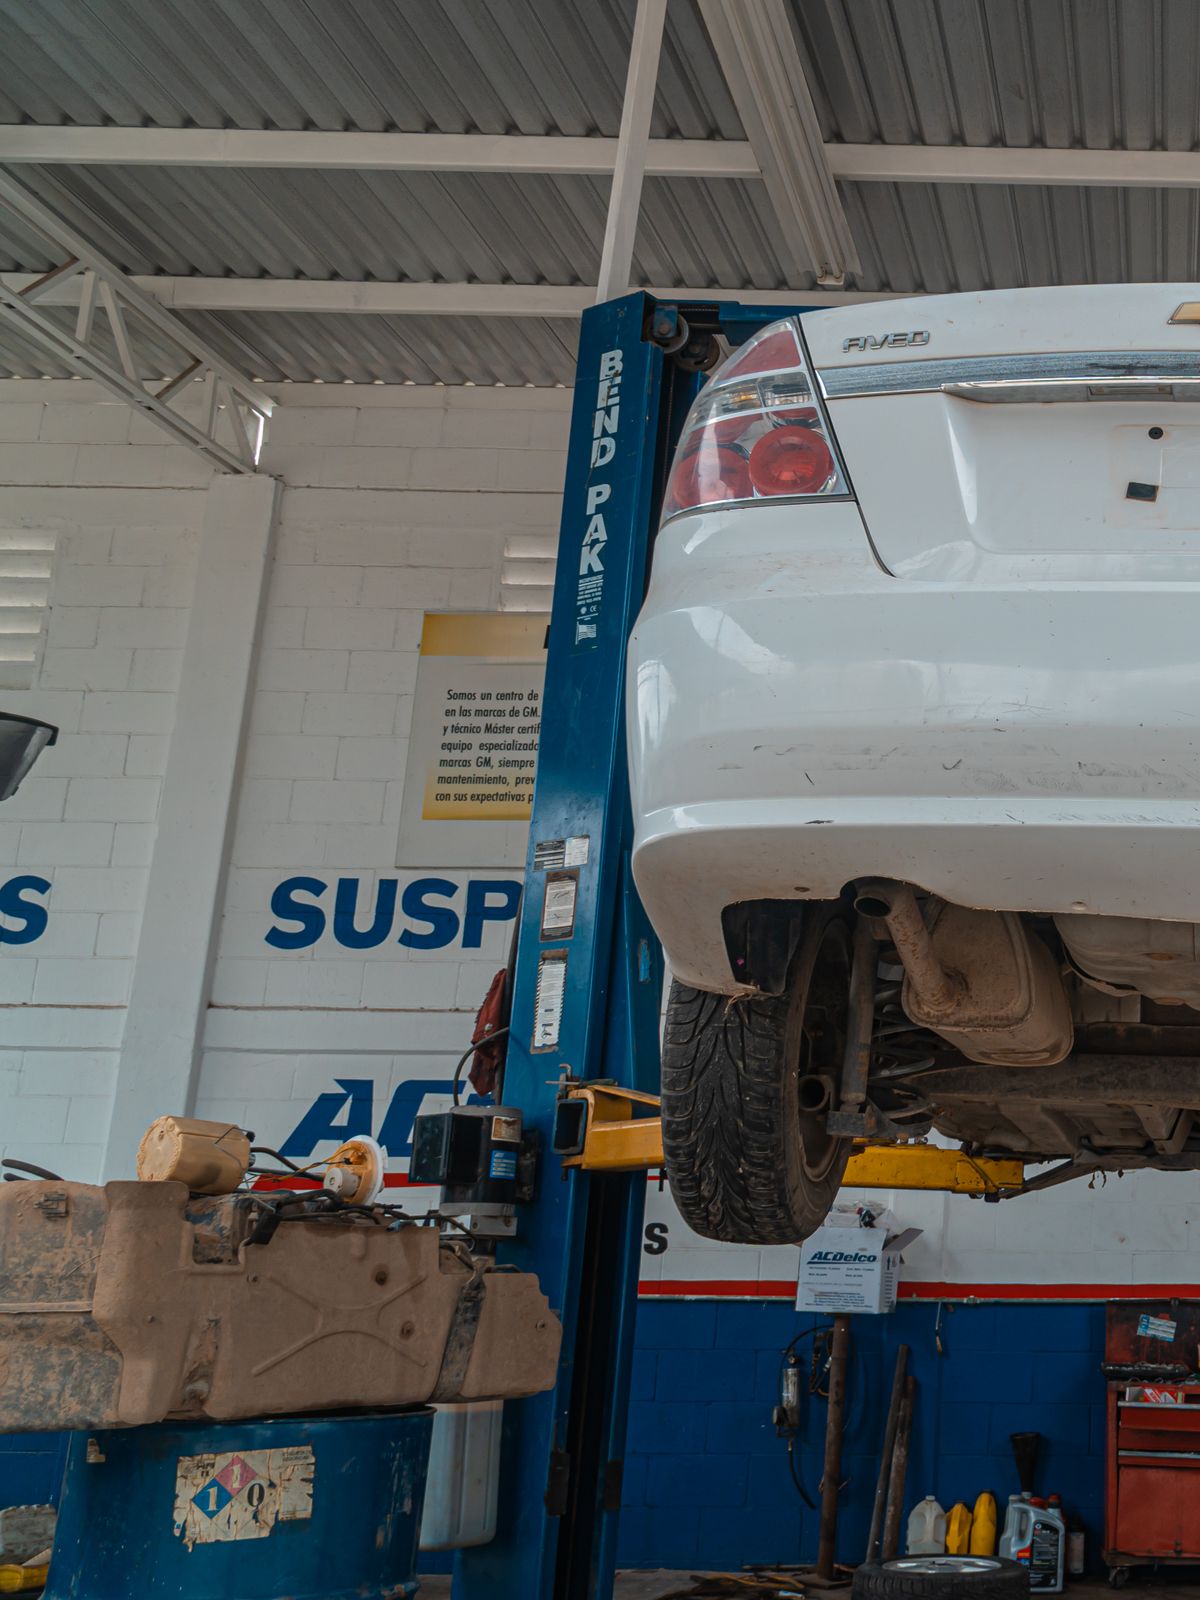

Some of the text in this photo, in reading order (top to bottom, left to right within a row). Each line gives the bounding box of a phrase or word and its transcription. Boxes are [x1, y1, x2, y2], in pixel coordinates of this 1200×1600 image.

[842, 330, 930, 353] AVEO
[590, 349, 624, 469] BEND
[579, 483, 612, 576] PAK
[447, 689, 539, 701] Somos un centro de
[445, 708, 456, 717] en
[459, 706, 472, 717] las
[474, 708, 506, 717] marcas
[509, 706, 520, 717] de
[443, 725, 449, 736] y
[450, 722, 482, 734] técnico
[484, 722, 515, 734] Máster
[441, 740, 473, 753] equipo
[439, 756, 535, 770] marcas GM, siempre
[437, 774, 510, 786] mantenimiento,
[435, 792, 451, 802] con
[453, 792, 468, 802] sus
[470, 790, 526, 804] expectativas
[264, 877, 523, 950] SUSP
[810, 1251, 877, 1263] ACDelco
[230, 1463, 242, 1489] 1
[206, 1486, 219, 1512] 1
[247, 1482, 265, 1508] 0
